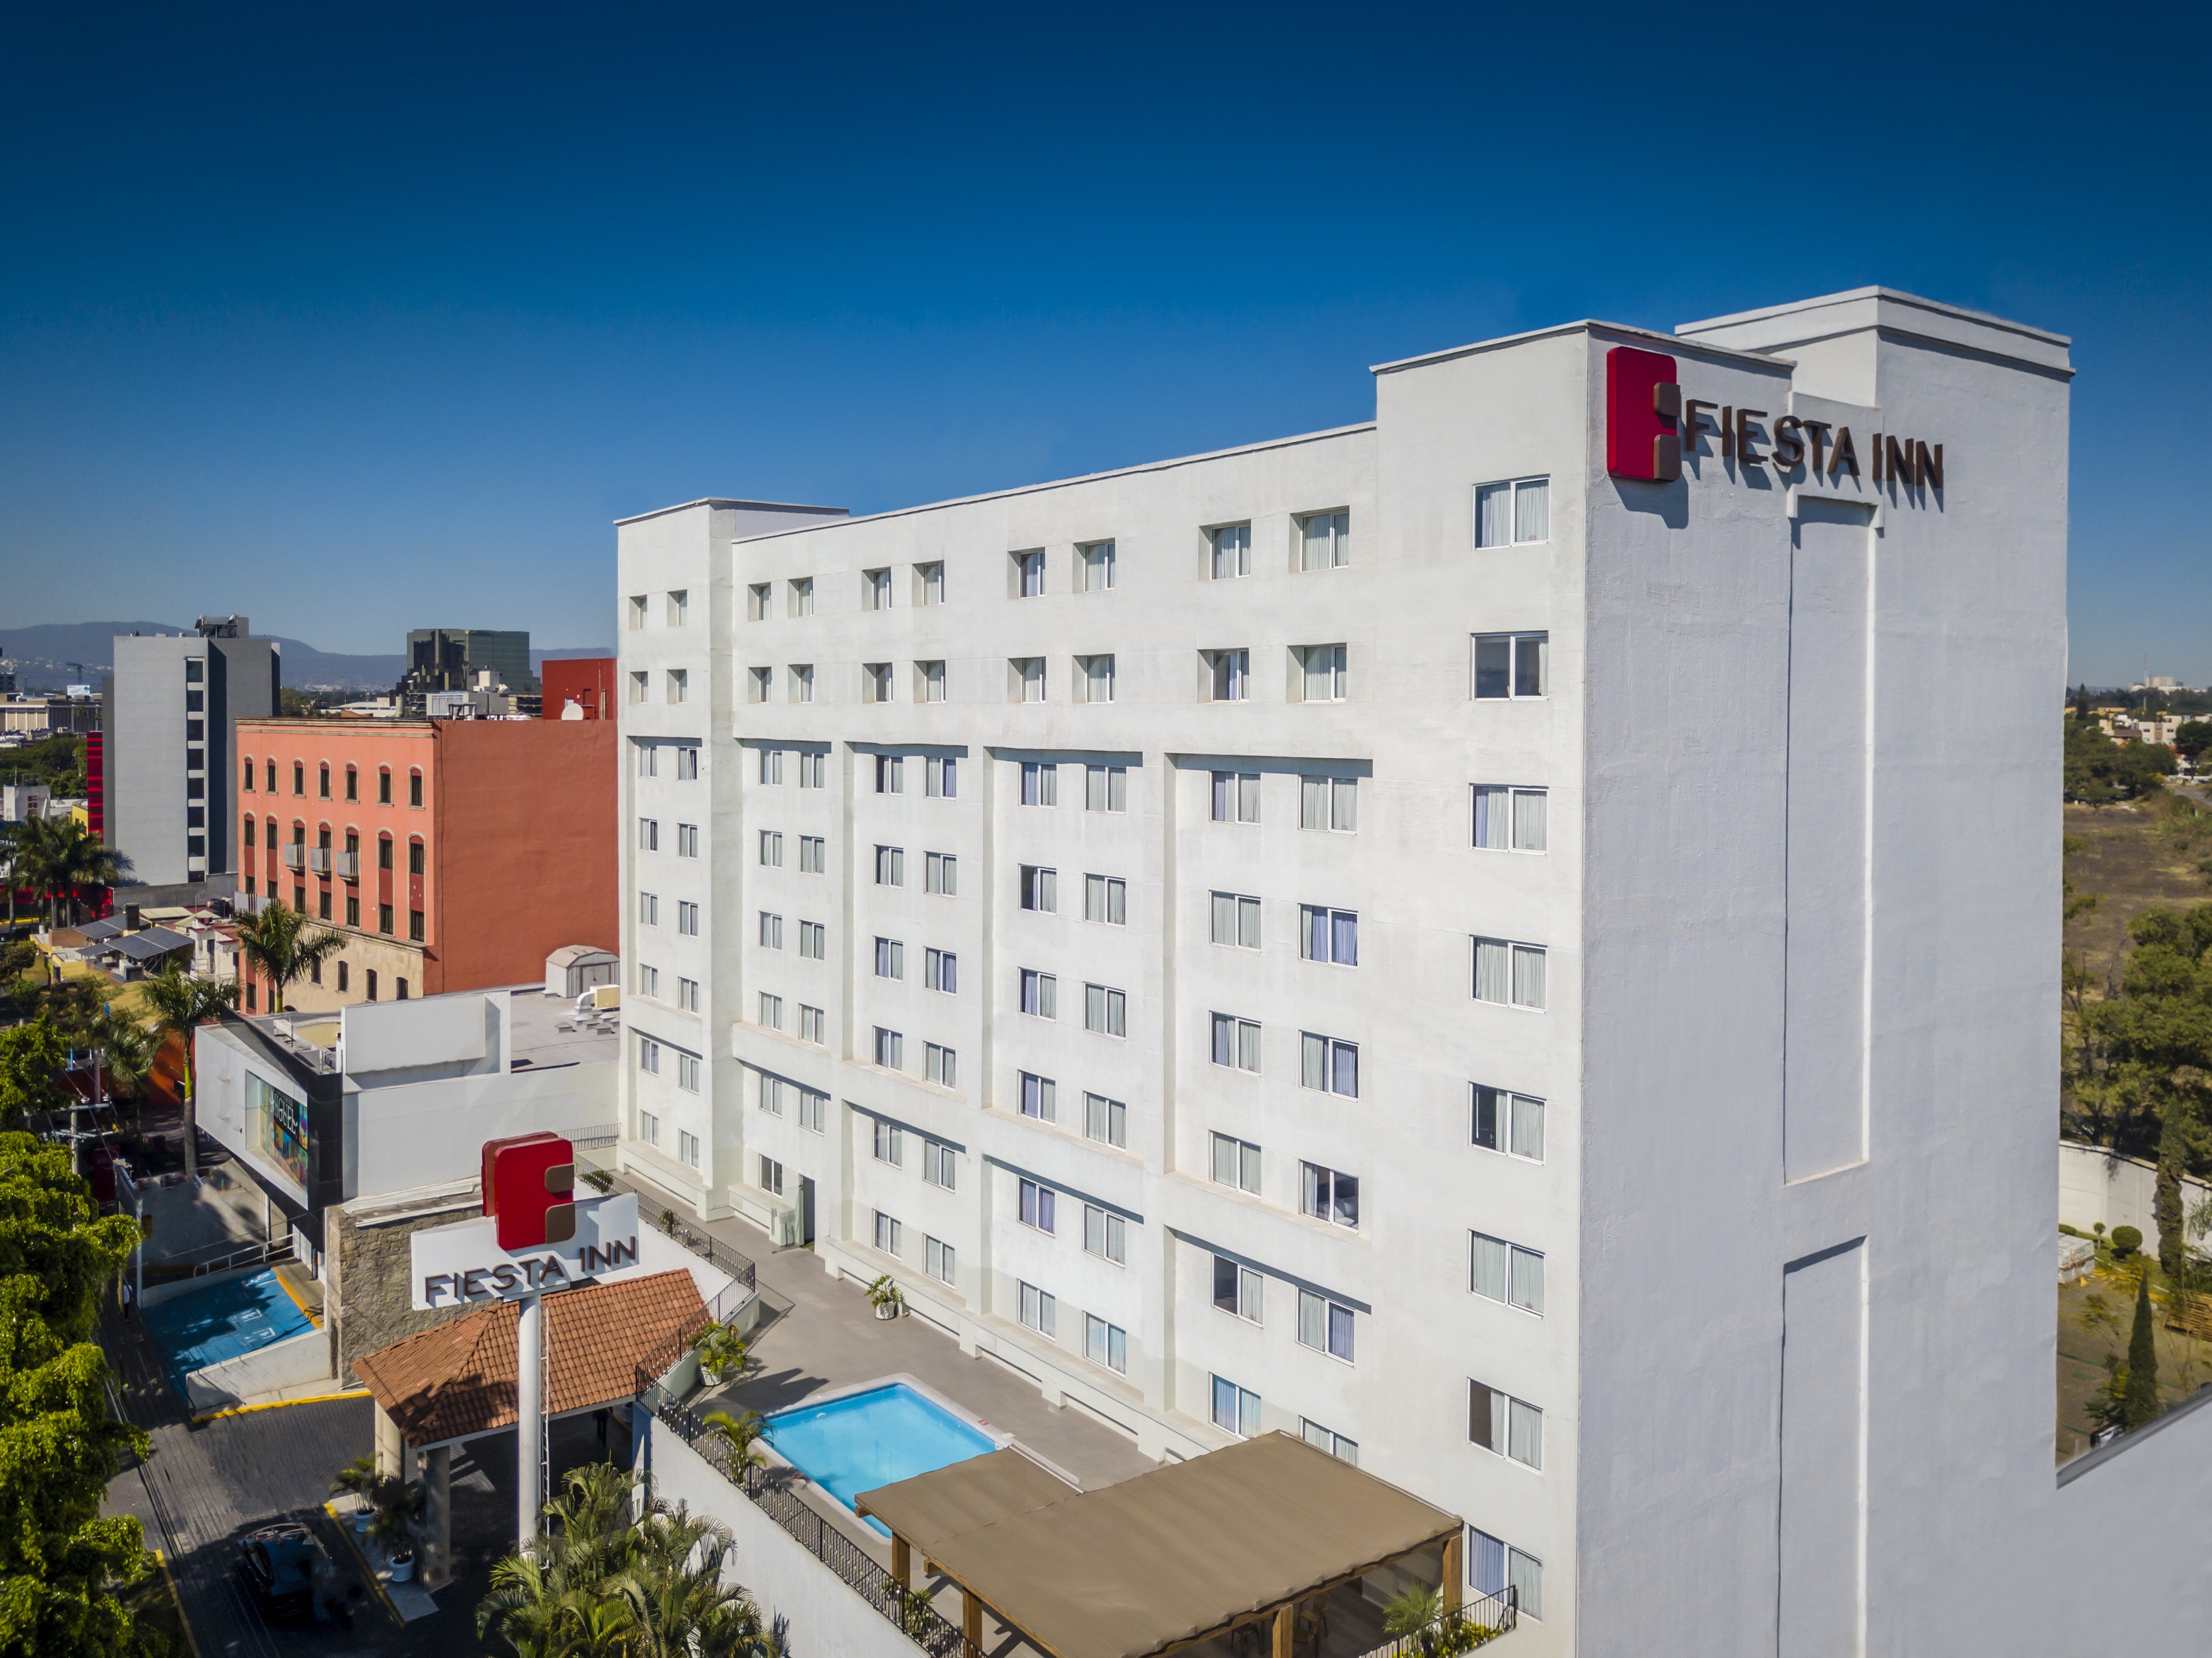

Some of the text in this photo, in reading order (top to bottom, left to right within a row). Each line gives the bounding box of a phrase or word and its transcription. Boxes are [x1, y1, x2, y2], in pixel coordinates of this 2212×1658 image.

[1685, 399, 1943, 489] FIESTA INN
[425, 1236, 636, 1303] FIESTA INN
